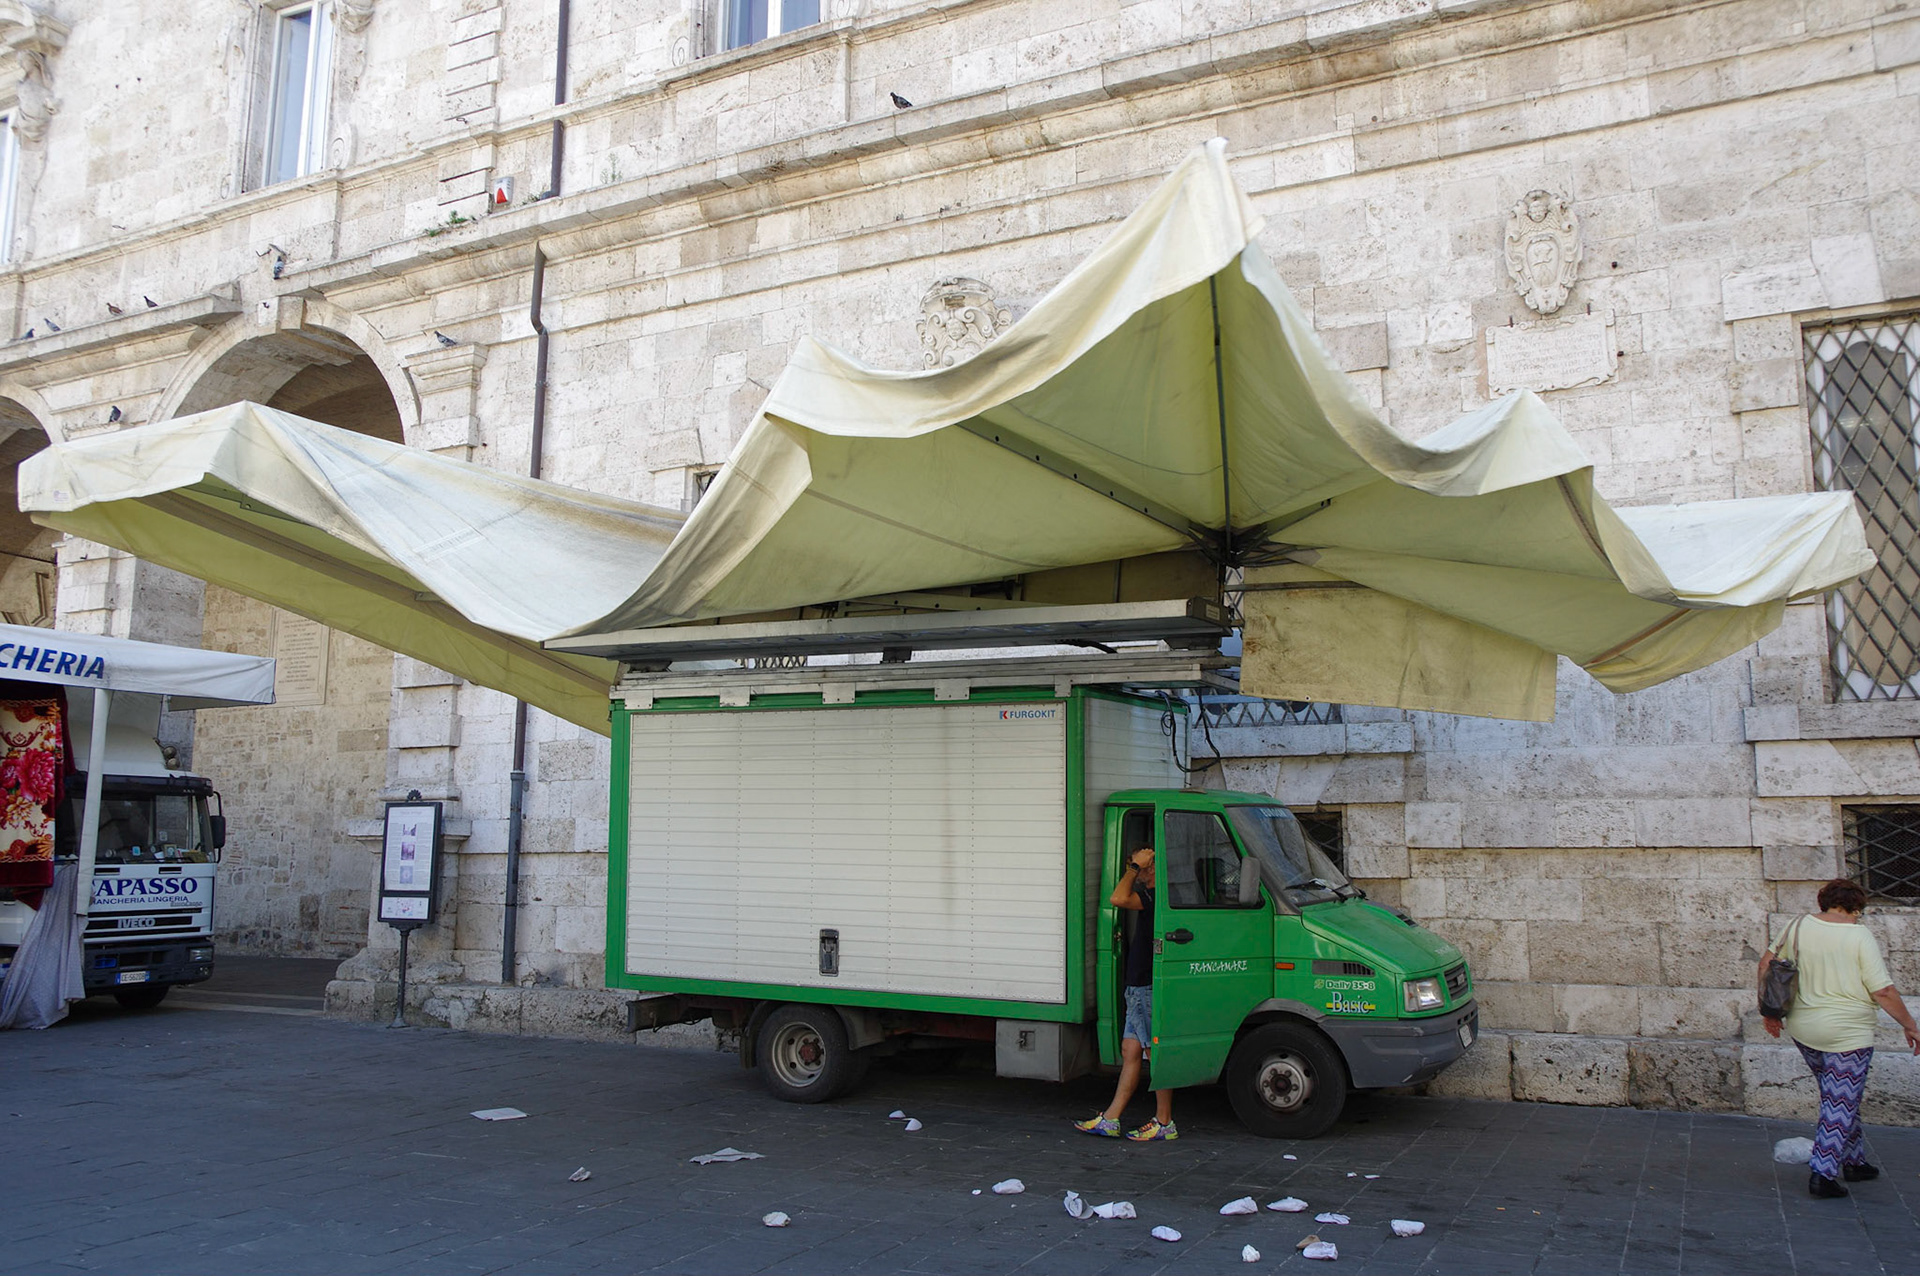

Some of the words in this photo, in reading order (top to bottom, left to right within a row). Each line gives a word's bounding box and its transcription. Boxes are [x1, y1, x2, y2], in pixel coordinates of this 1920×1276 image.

[1010, 710, 1056, 719] FURGOKIT
[92, 877, 198, 896] APASSO
[92, 896, 146, 905] IANCHERIA
[118, 918, 156, 929] IVECO
[1189, 960, 1248, 975] FRANCAMARE
[1325, 980, 1351, 990] Daily
[1331, 992, 1370, 1014] Basic
